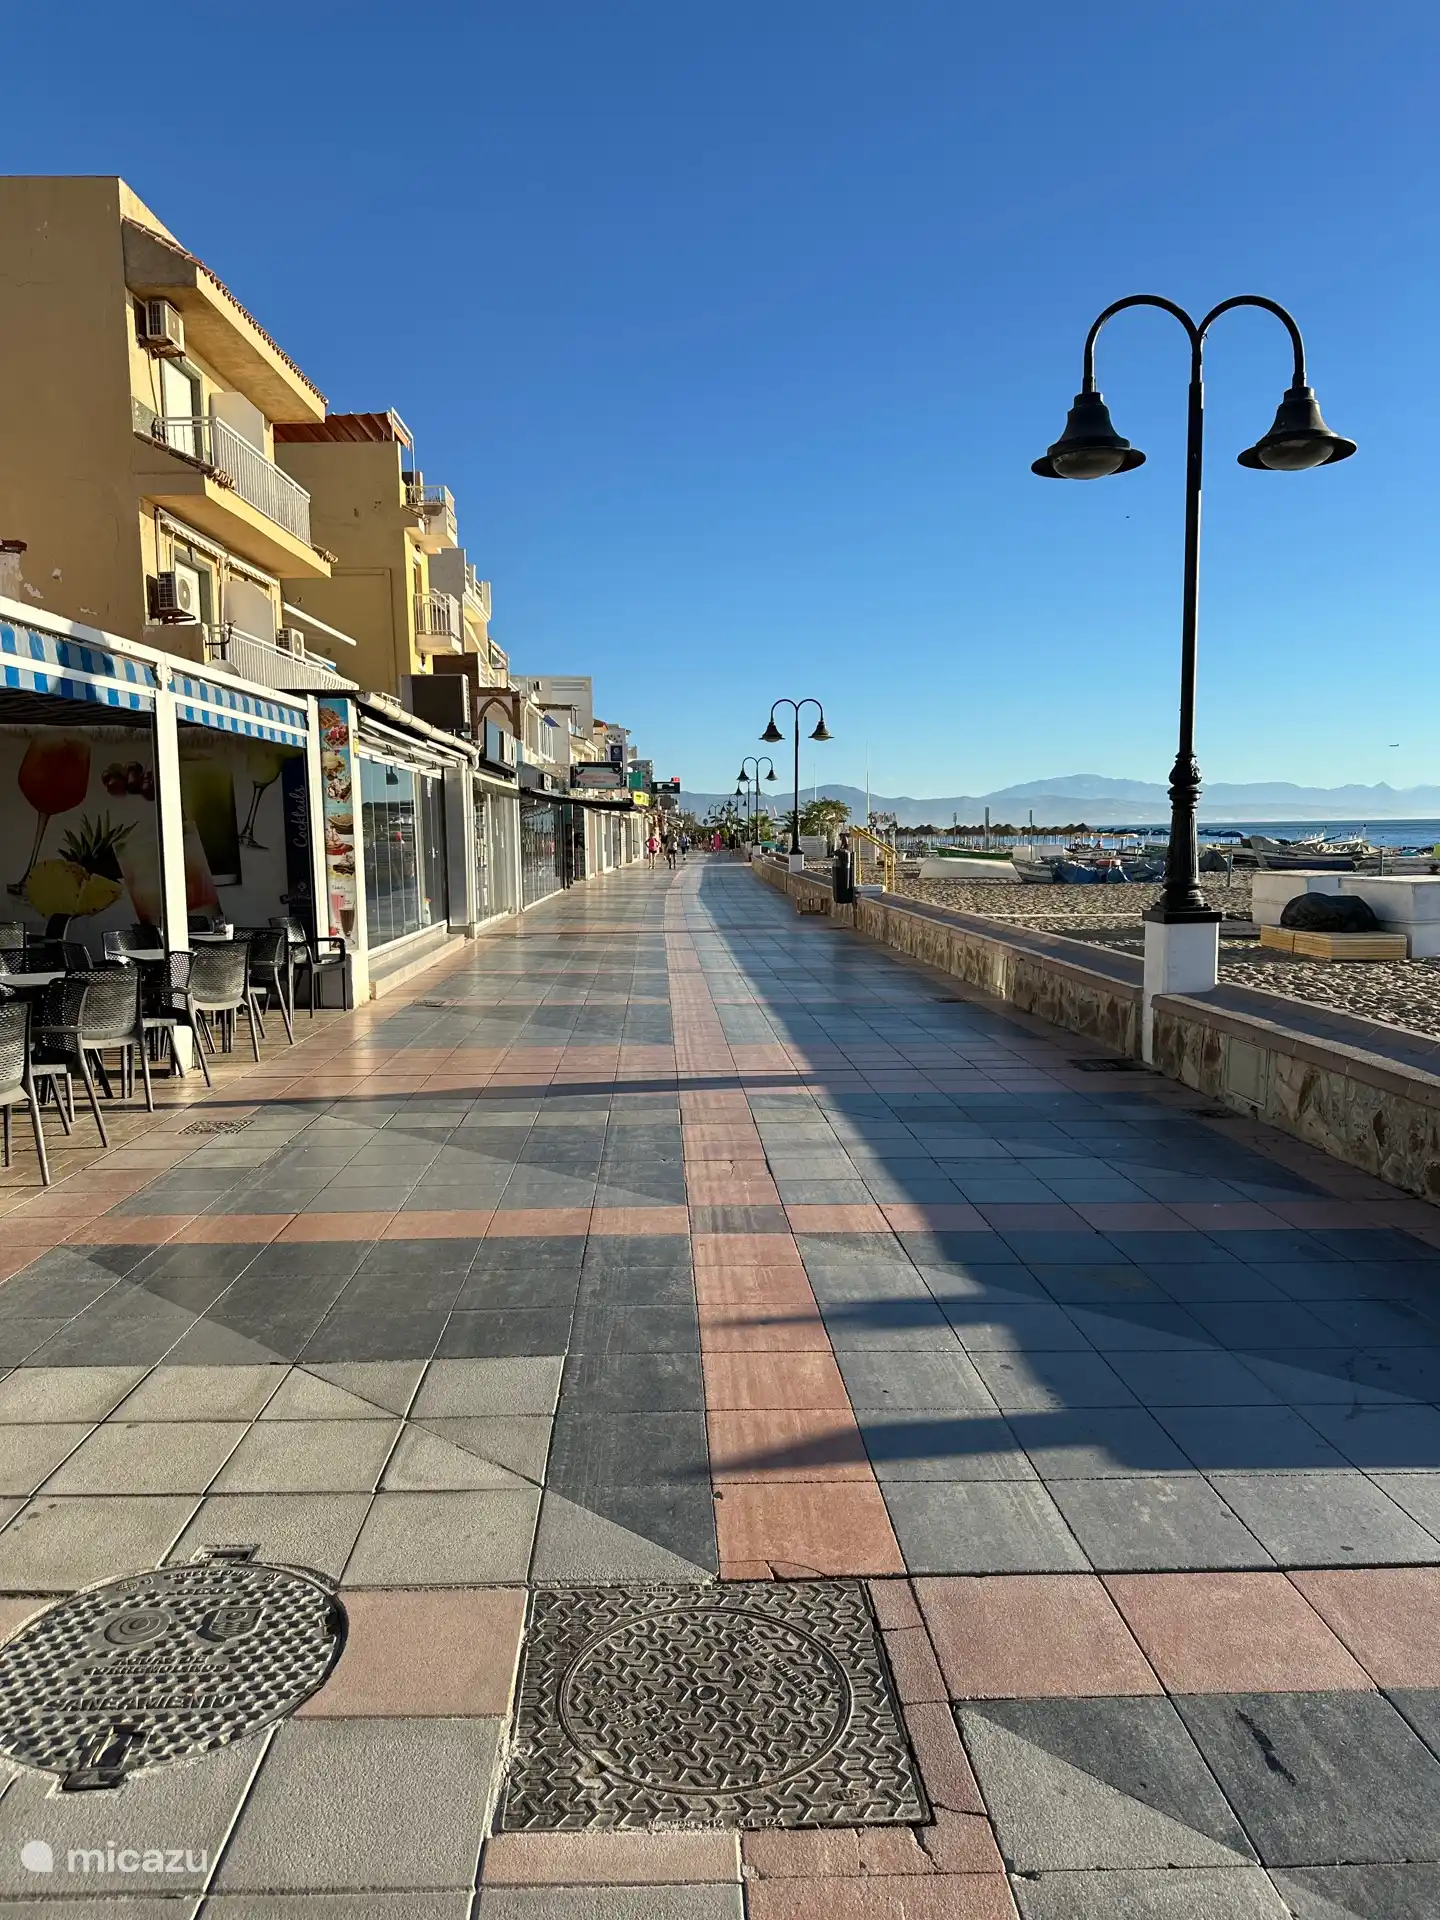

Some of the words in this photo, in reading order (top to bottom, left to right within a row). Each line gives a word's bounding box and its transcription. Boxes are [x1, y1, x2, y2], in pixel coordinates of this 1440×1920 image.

[289, 784, 308, 848] Cocktails
[112, 1655, 178, 1666] AGUAS
[179, 1655, 209, 1666] DE
[84, 1663, 231, 1676] TORREMOLINOS
[43, 1694, 236, 1712] SANEAMIENTO
